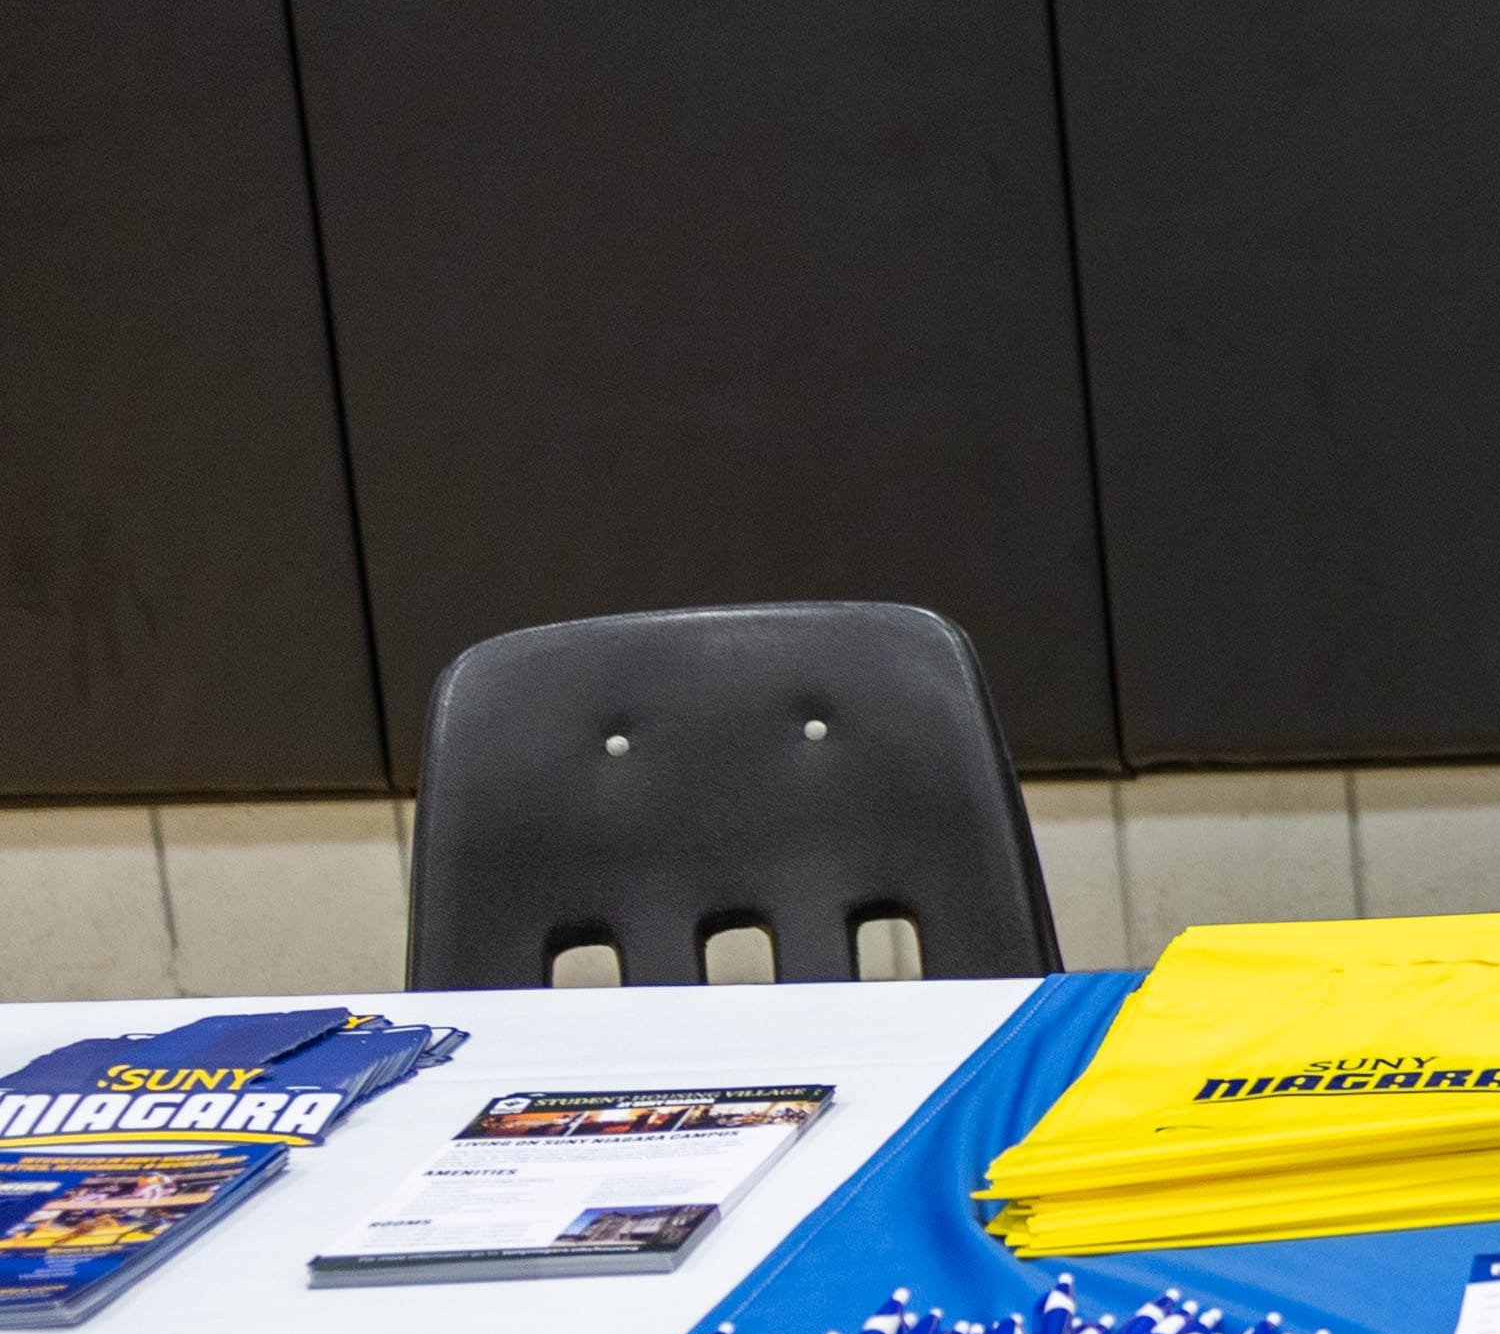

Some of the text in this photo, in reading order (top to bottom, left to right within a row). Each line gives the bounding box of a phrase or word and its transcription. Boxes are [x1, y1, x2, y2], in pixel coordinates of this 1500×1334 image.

[1304, 1056, 1439, 1072] SUNY
[108, 1067, 266, 1091] SUNY
[726, 1088, 807, 1099] VILLAGE
[0, 1092, 344, 1137] NIAGARA
[422, 1168, 518, 1178] AMENITIES
